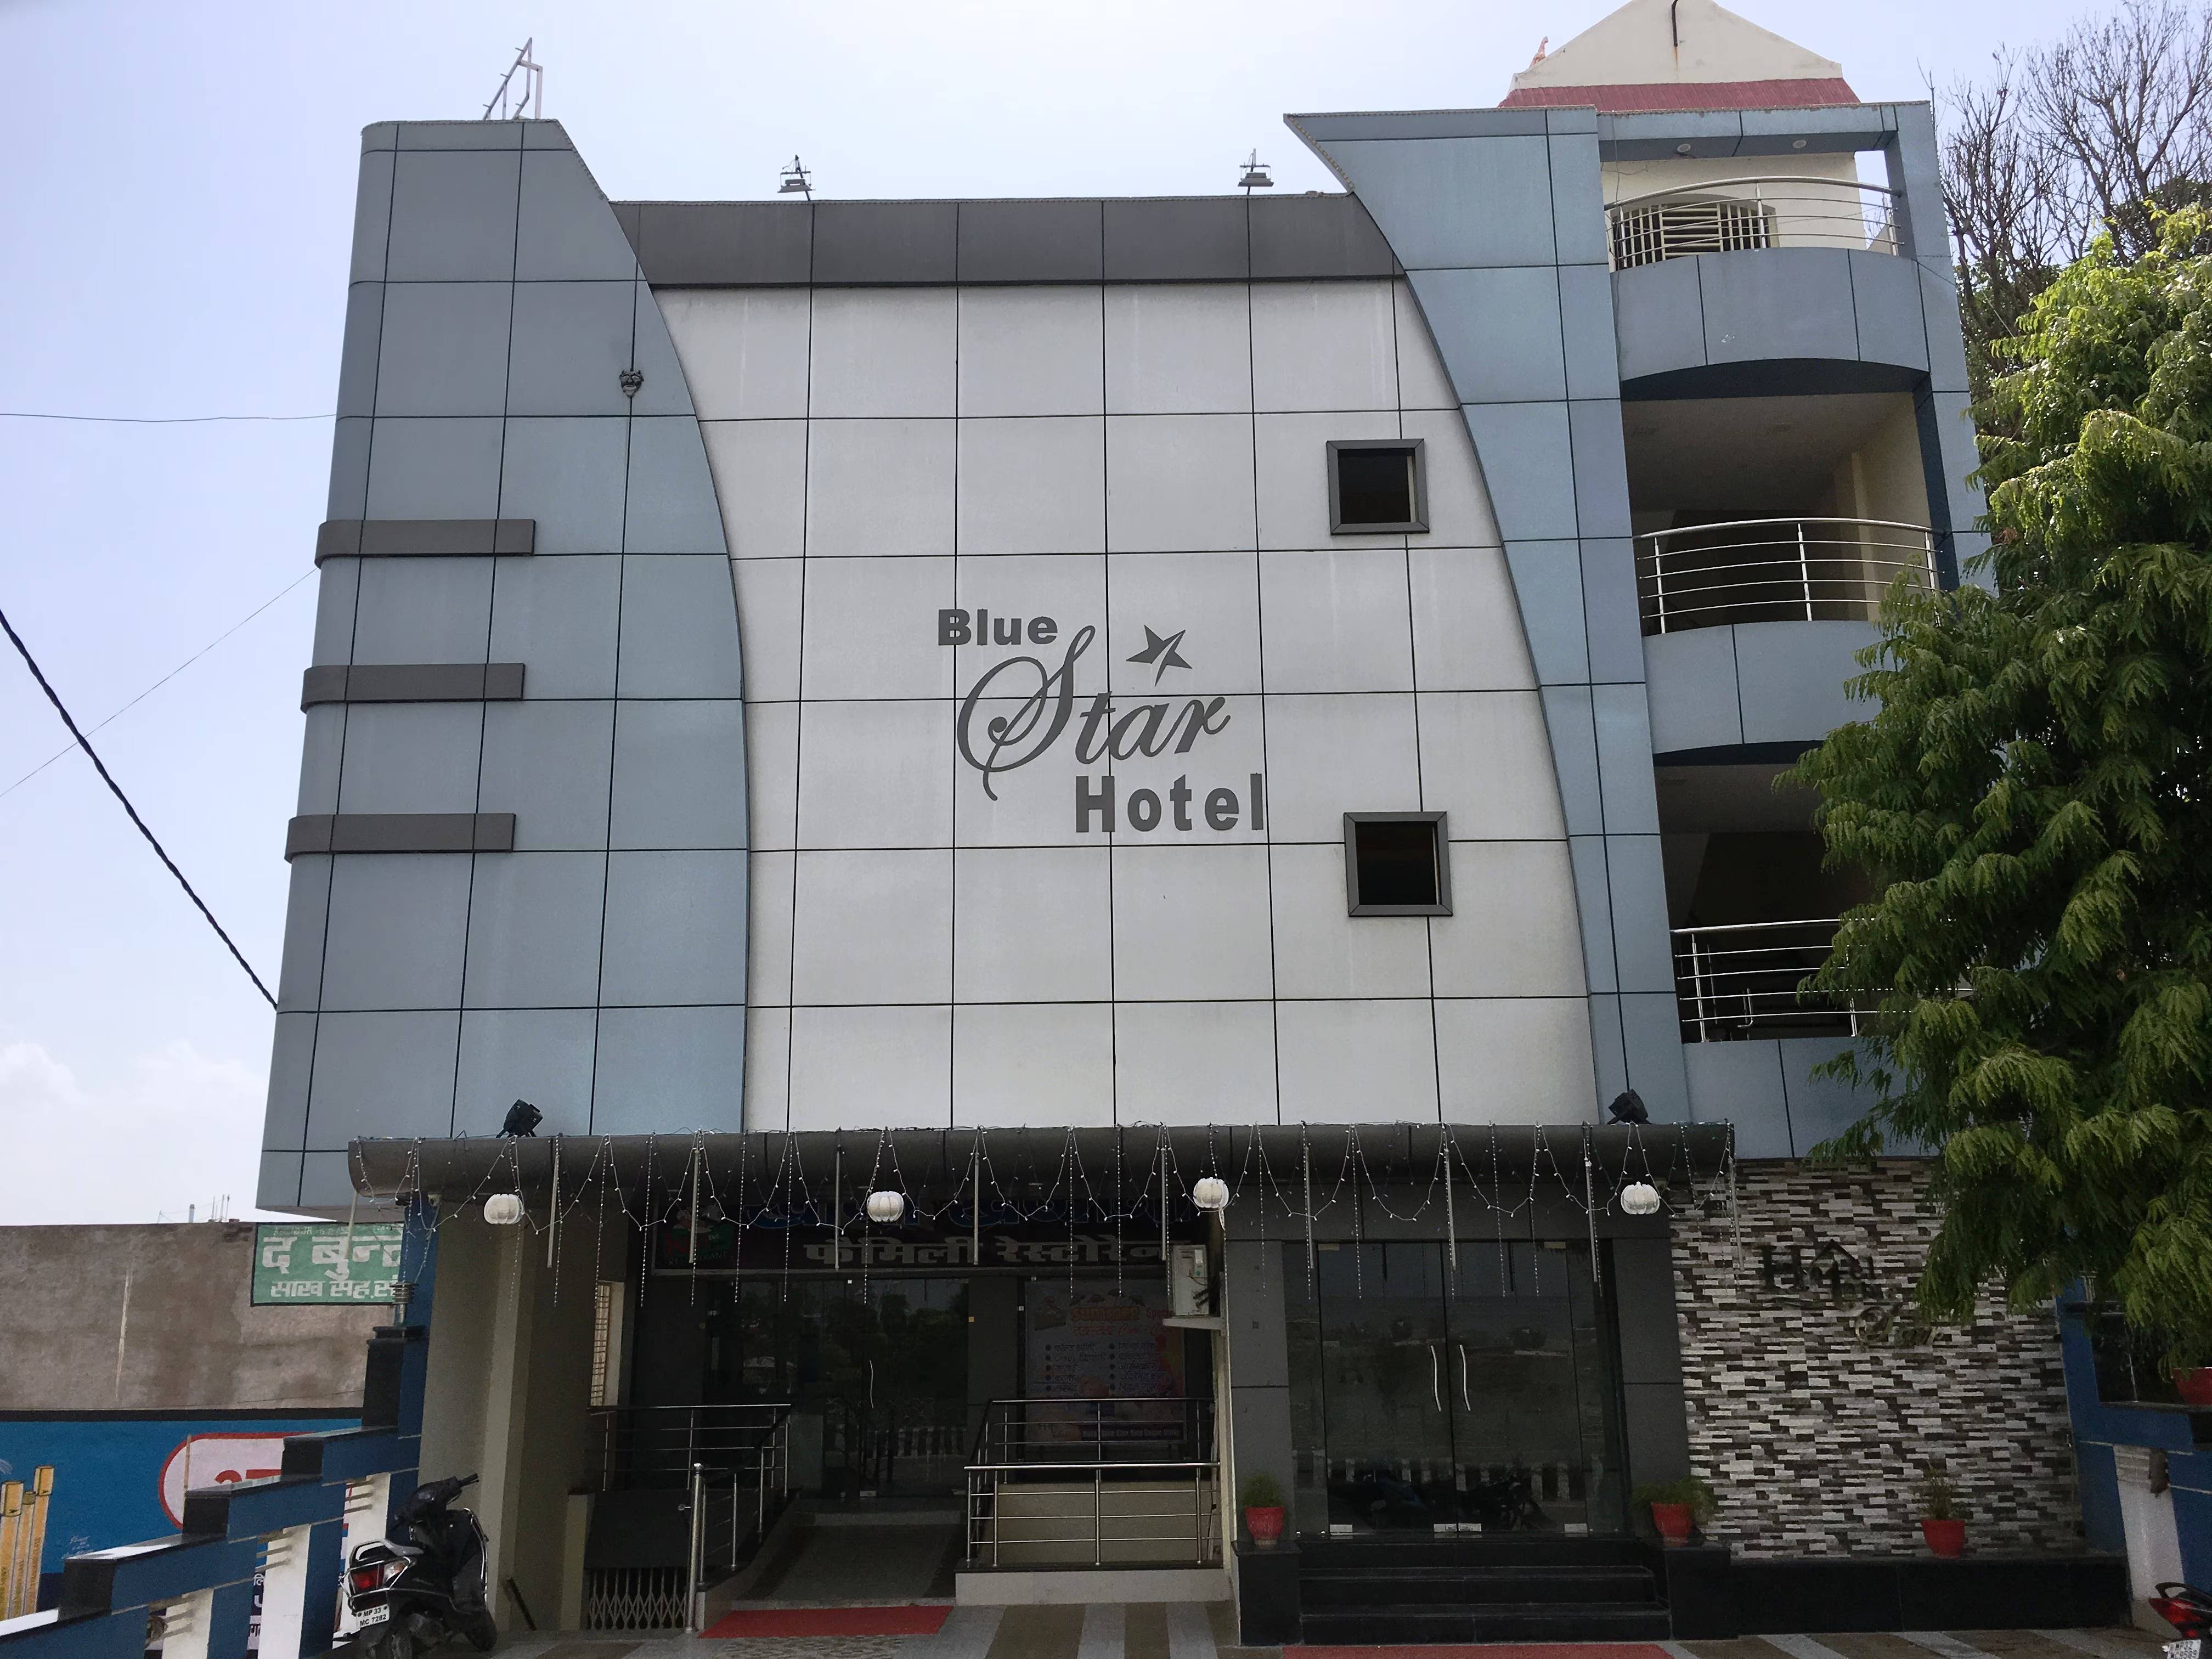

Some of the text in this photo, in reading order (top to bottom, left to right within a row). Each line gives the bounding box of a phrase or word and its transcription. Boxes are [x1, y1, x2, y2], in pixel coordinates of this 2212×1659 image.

[938, 608, 1058, 646] Blue
[957, 625, 1231, 802] Star
[1075, 773, 1263, 833] Hotel
